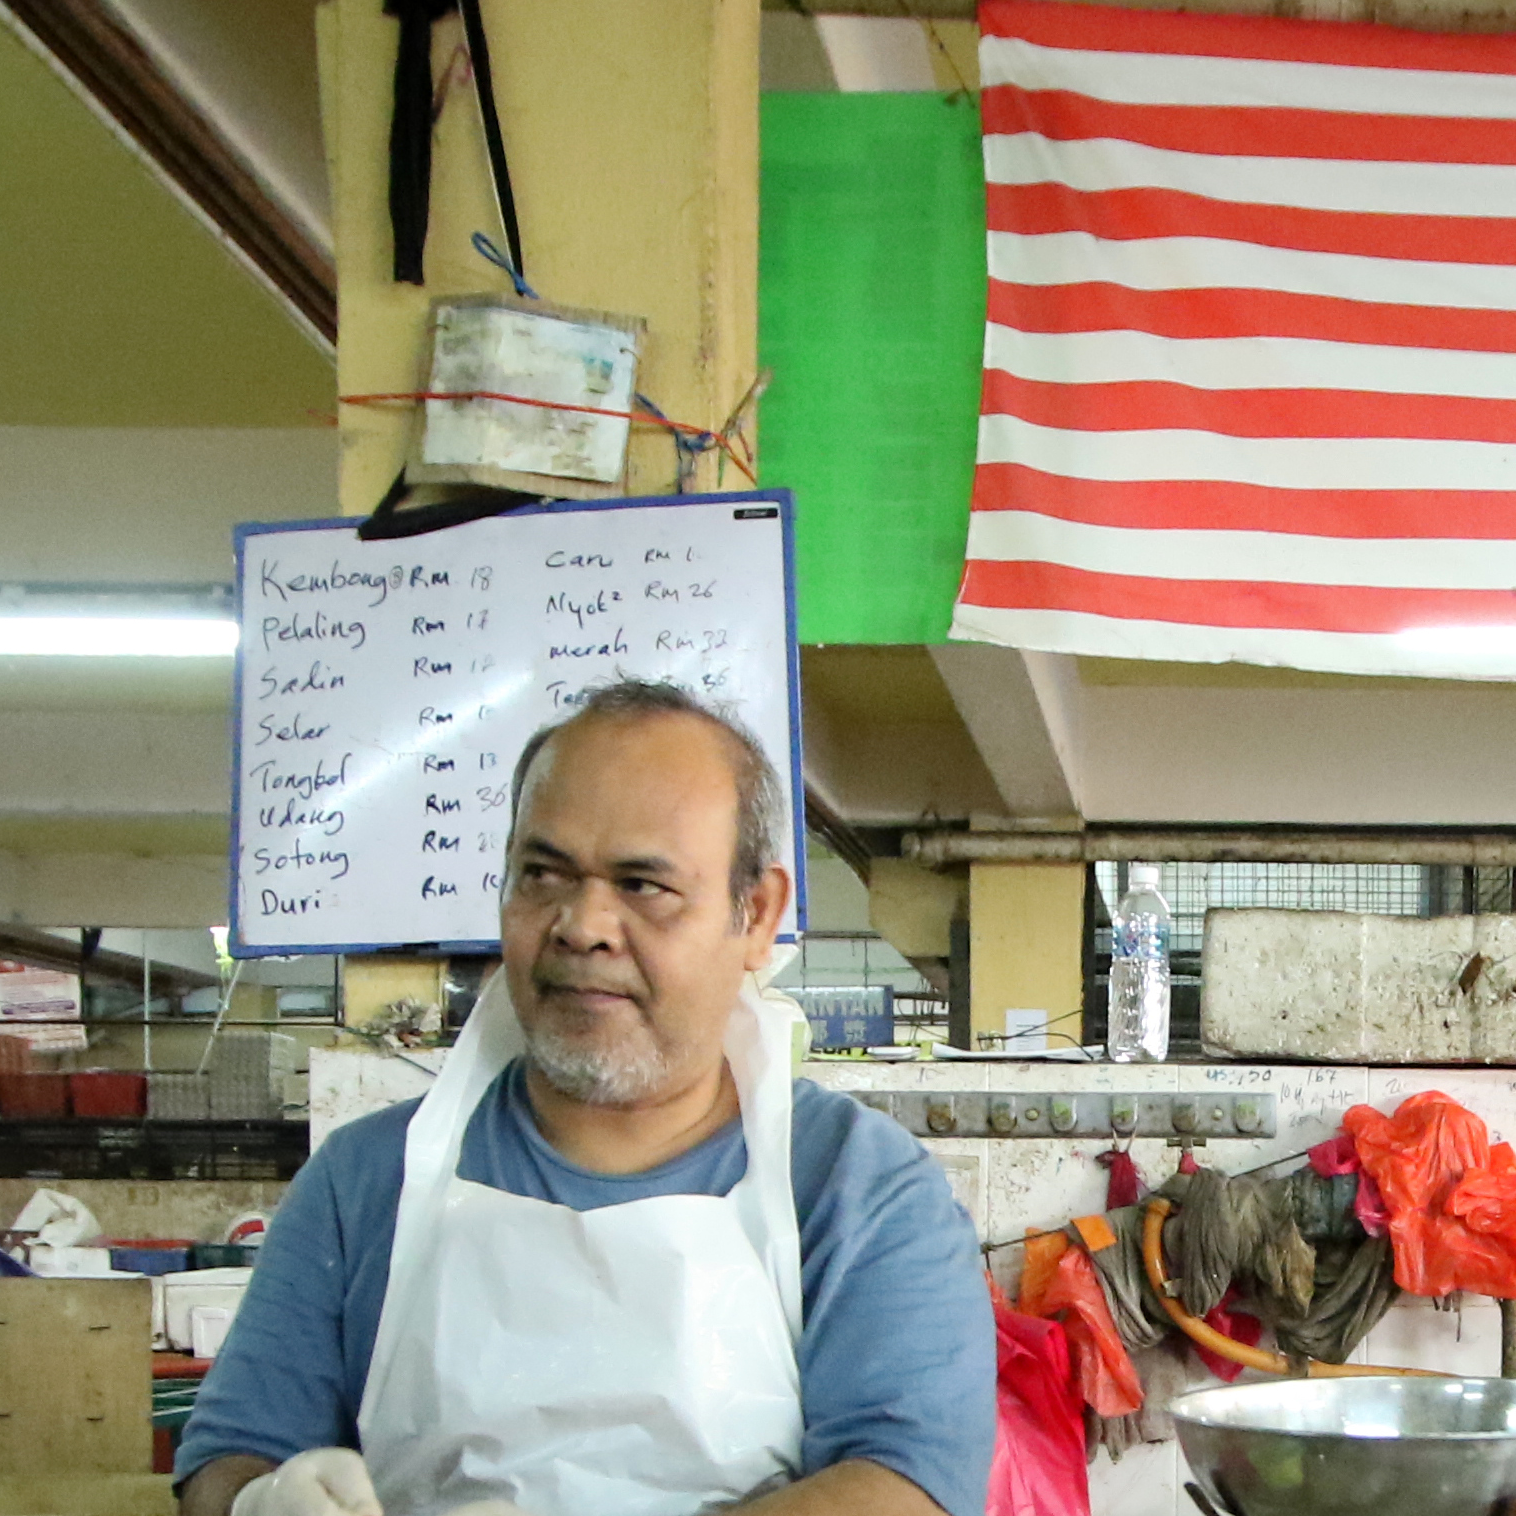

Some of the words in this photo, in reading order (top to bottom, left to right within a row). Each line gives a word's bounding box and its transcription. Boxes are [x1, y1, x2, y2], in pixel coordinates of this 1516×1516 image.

[409, 566, 449, 586] Rm
[688, 580, 717, 598] 26
[411, 617, 445, 635] Rm
[413, 656, 452, 676] Rm
[260, 889, 322, 915] Duri
